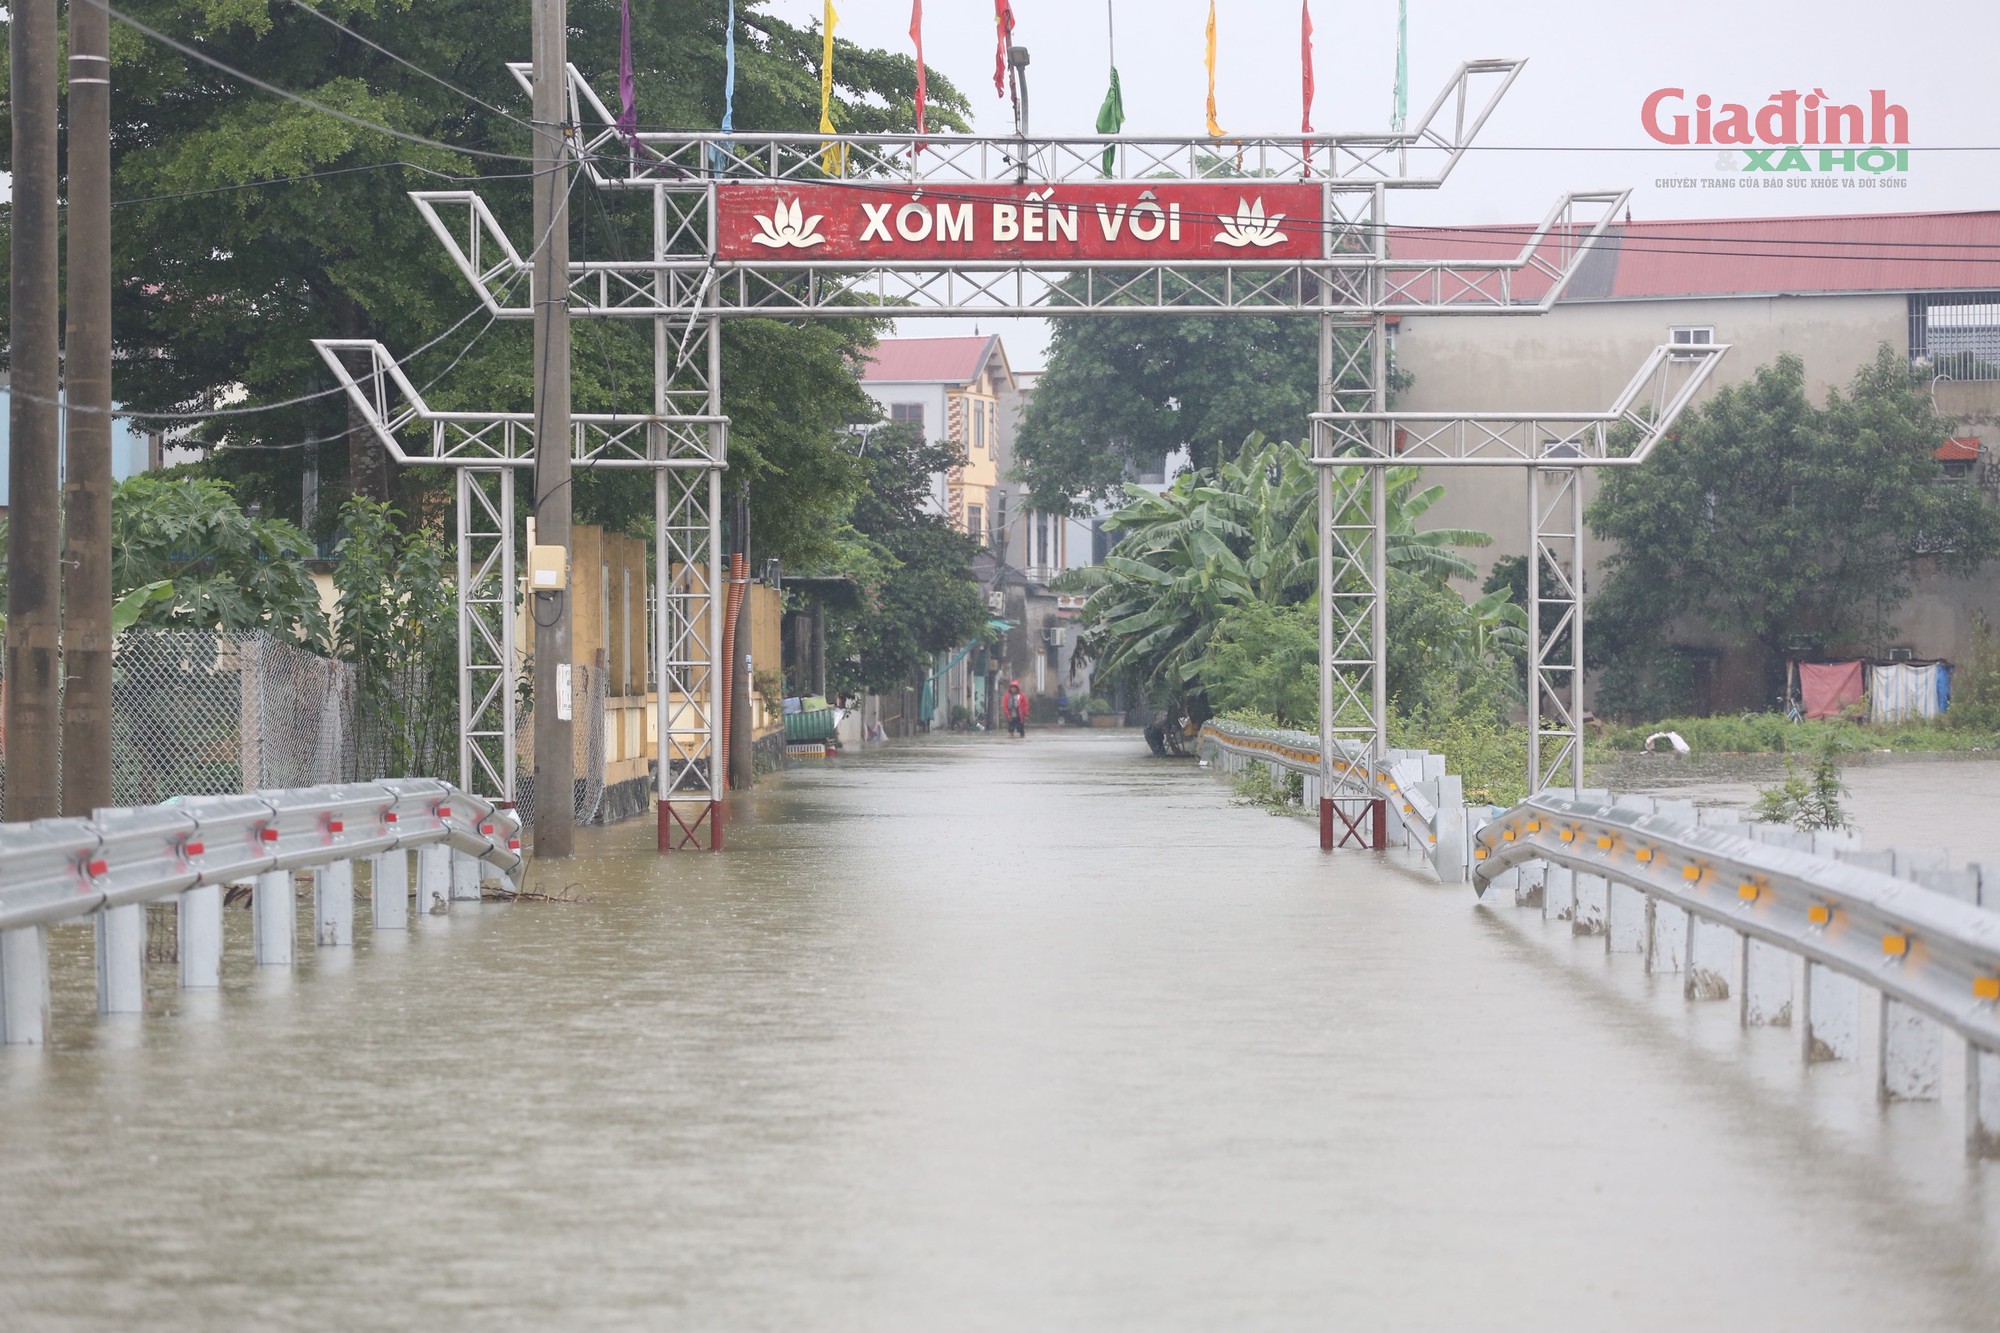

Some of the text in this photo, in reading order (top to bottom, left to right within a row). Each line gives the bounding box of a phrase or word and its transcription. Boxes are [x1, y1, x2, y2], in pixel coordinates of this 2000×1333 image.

[859, 186, 1180, 242] XÓM BẾN VÔI
